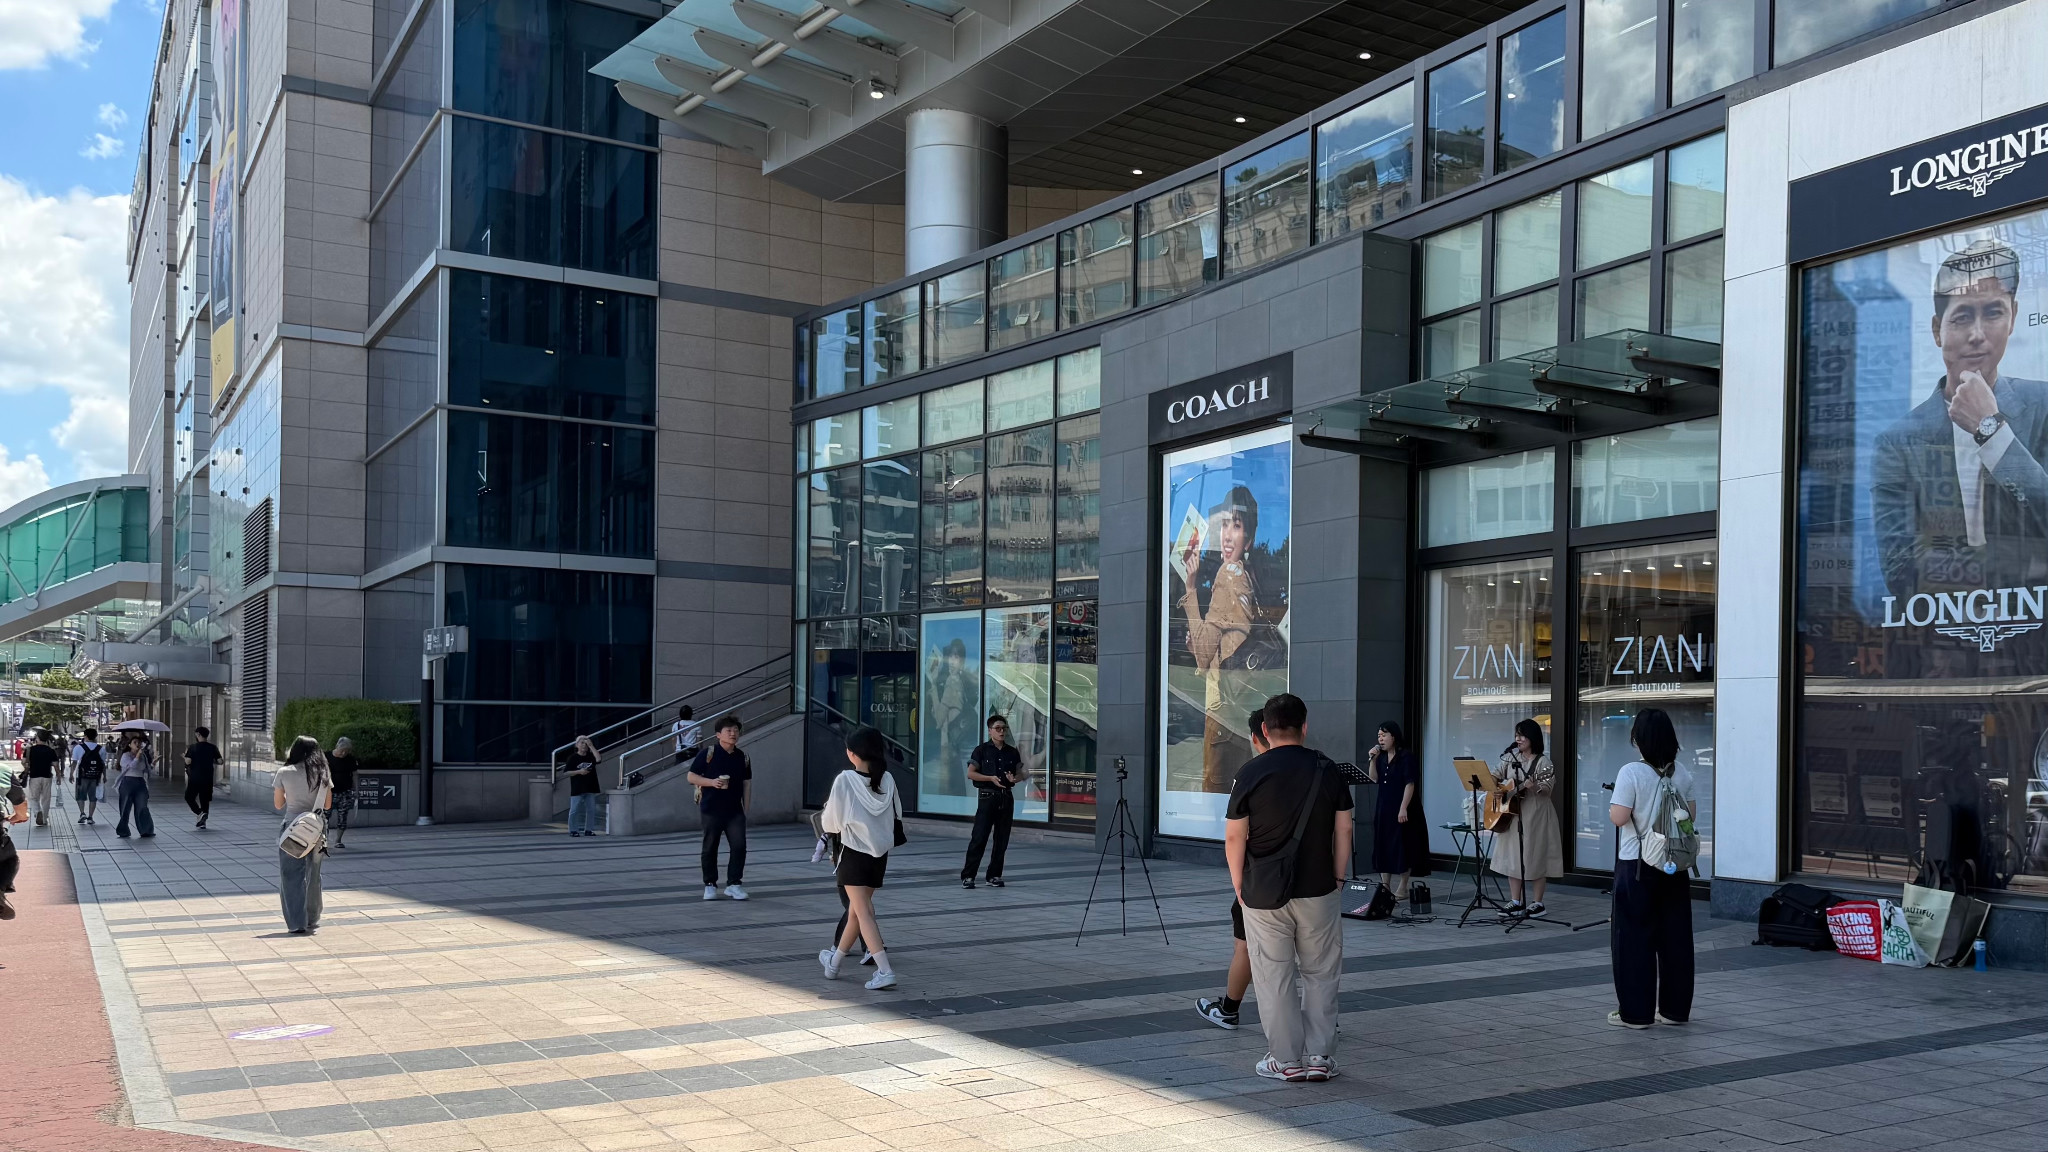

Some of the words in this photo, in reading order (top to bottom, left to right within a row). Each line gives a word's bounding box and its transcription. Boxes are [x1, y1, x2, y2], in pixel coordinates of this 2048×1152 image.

[1890, 123, 2048, 196] LONGINE
[1167, 377, 1269, 423] COACH
[1881, 585, 2047, 628] LONGIN
[1453, 642, 1524, 680] ZIAN
[1612, 632, 1703, 676] ZIAN
[1467, 685, 1507, 696] BOUTIQUE
[1631, 682, 1681, 693] BOUTIQUE
[870, 702, 907, 713] COACH
[1882, 940, 1916, 961] EARTH
